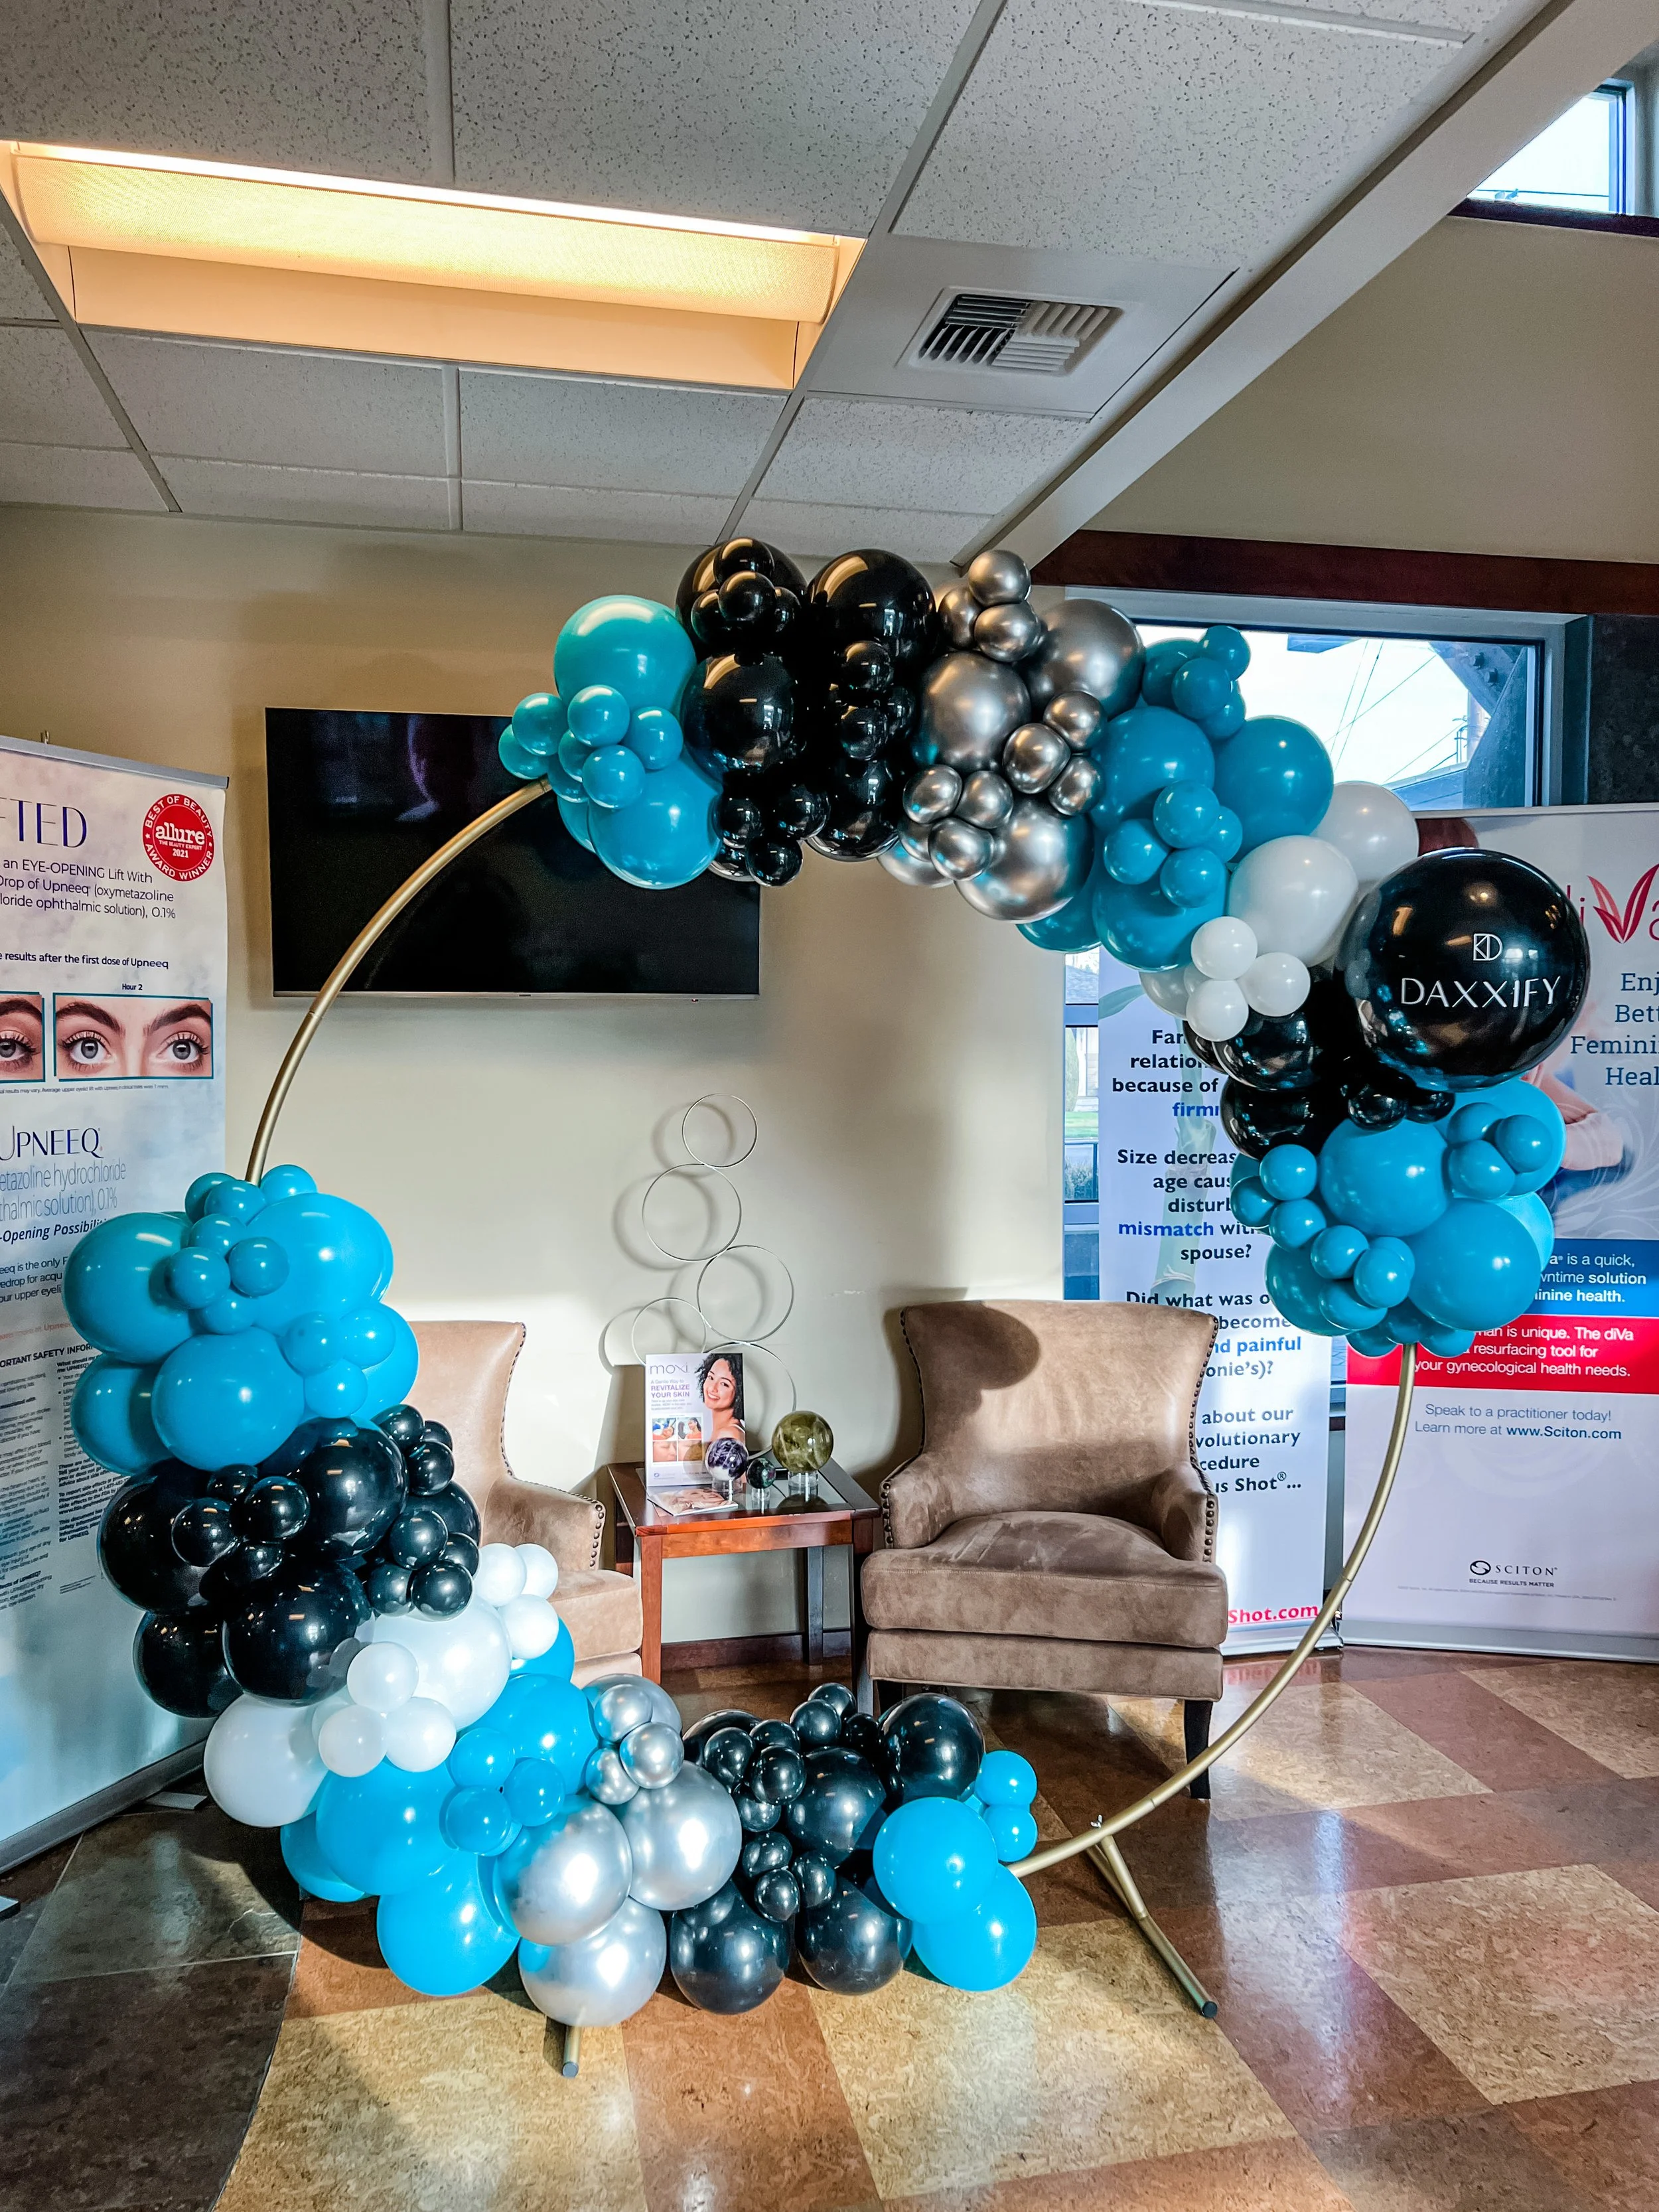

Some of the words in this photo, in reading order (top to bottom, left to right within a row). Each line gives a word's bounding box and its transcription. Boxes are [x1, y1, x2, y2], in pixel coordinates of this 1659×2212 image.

[145, 800, 165, 828] BEST
[167, 796, 180, 804] OF
[183, 798, 212, 838] BEAUTY
[155, 822, 205, 846] allure
[173, 849, 189, 858] 2021
[145, 844, 175, 877] AWARD
[179, 850, 213, 880] WINNER
[3, 859, 18, 869] an
[23, 859, 105, 879] EYE-OPENING
[108, 868, 125, 881] Lift
[127, 870, 153, 883] With
[28, 878, 40, 889] of
[94, 883, 174, 902] (oxymetazoline
[36, 897, 101, 913] ophthalmic
[104, 903, 147, 919] solution),
[152, 907, 176, 919] 0.1%
[5, 952, 36, 962] results
[39, 953, 62, 962] after
[65, 954, 80, 963] the
[82, 954, 100, 964] first
[102, 956, 120, 966] dose
[131, 958, 169, 970] Upneeq
[1401, 976, 1561, 1007] DAXXIFY
[1112, 1078, 1192, 1092] because
[1199, 1078, 1219, 1092] of
[1118, 1149, 1157, 1164] Size
[54, 1157, 126, 1192] hydrochloride
[1153, 1177, 1188, 1193] age
[44, 1189, 96, 1217] solution),
[98, 1187, 117, 1211] 0.1%
[1118, 1221, 1214, 1236] mismatch
[1181, 1244, 1252, 1264] spouse?
[1567, 1254, 1577, 1265] is
[1582, 1256, 1591, 1265] a
[1595, 1254, 1634, 1268] quick,
[17, 1262, 23, 1272] is
[25, 1260, 39, 1270] the
[41, 1258, 60, 1268] only
[0, 1276, 25, 1288] edrop
[27, 1274, 37, 1284] for
[1588, 1272, 1646, 1285] solution
[15, 1289, 39, 1301] upper
[1126, 1291, 1159, 1305] Did
[1165, 1293, 1213, 1307] what
[1218, 1295, 1253, 1306] was
[1577, 1290, 1625, 1302] health.
[1507, 1325, 1518, 1337] is
[1522, 1326, 1570, 1341] unique.
[1574, 1327, 1601, 1339] The
[1604, 1328, 1634, 1341] diVa
[33, 1347, 65, 1361] SAFETY
[67, 1343, 93, 1355] INFOR
[1237, 1336, 1301, 1357] painful
[1473, 1343, 1547, 1359] resurfacing
[1550, 1345, 1576, 1357] tool
[1579, 1345, 1599, 1358] for
[650, 1362, 688, 1374] moxi
[1415, 1361, 1443, 1372] your
[1447, 1361, 1537, 1376] gynecological
[1540, 1363, 1581, 1375] health
[1585, 1364, 1630, 1376] needs.
[1202, 1408, 1256, 1425] about
[1262, 1409, 1293, 1421] our
[1425, 1404, 1465, 1417] Speak
[1470, 1406, 1481, 1417] to
[1486, 1408, 1493, 1417] a
[1497, 1407, 1569, 1420] practitioner
[1573, 1409, 1611, 1423] today!
[1415, 1421, 1450, 1434] Learn
[1451, 1425, 1486, 1435] more
[1490, 1426, 1502, 1435] at
[1506, 1426, 1621, 1439] www.Sciton.com
